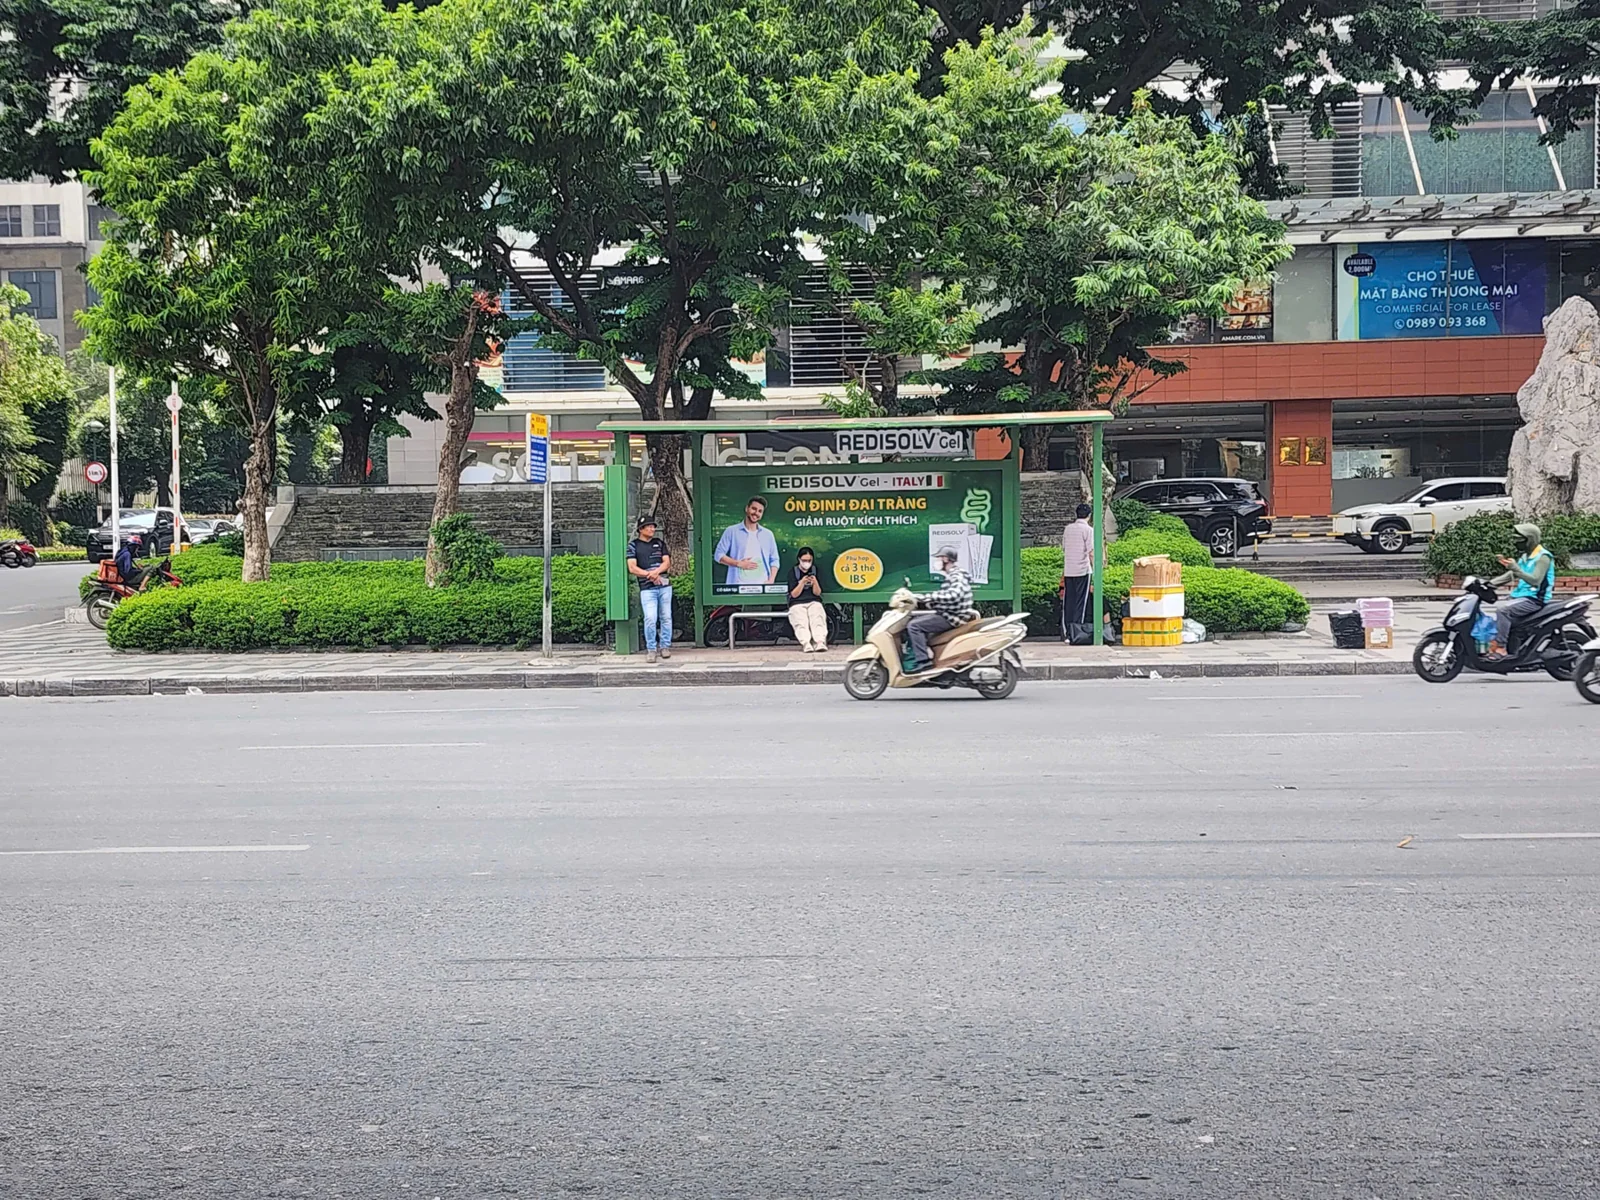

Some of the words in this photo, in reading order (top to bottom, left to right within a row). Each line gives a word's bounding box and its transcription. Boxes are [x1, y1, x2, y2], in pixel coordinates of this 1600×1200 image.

[1407, 271, 1437, 282] CHO
[1440, 267, 1475, 280] THUÊ
[1360, 286, 1387, 302] MẶT
[1431, 285, 1489, 298] THƯƠNG
[1492, 284, 1518, 298] MẠI
[1375, 303, 1445, 314] COMMERCIAL
[1449, 302, 1469, 312] FOR
[1471, 301, 1501, 311] LEASE
[1406, 317, 1436, 328] 0989
[1439, 317, 1462, 328] 093
[1465, 316, 1487, 327] 368
[839, 432, 936, 451] REDISOLV
[939, 435, 962, 449] Gel
[766, 475, 857, 489] REDISOLV
[860, 477, 880, 488] Gel
[892, 476, 926, 487] ITALY
[809, 499, 846, 515] ĐỊNH
[848, 498, 875, 514] ĐẠI
[877, 496, 927, 510] TRÀNG
[794, 515, 823, 527] GIẢM
[826, 515, 855, 528] RUỘT
[857, 515, 883, 526] KÍCH
[884, 514, 918, 525] THÍCH
[852, 563, 858, 572] 3
[849, 574, 866, 584] IBS
